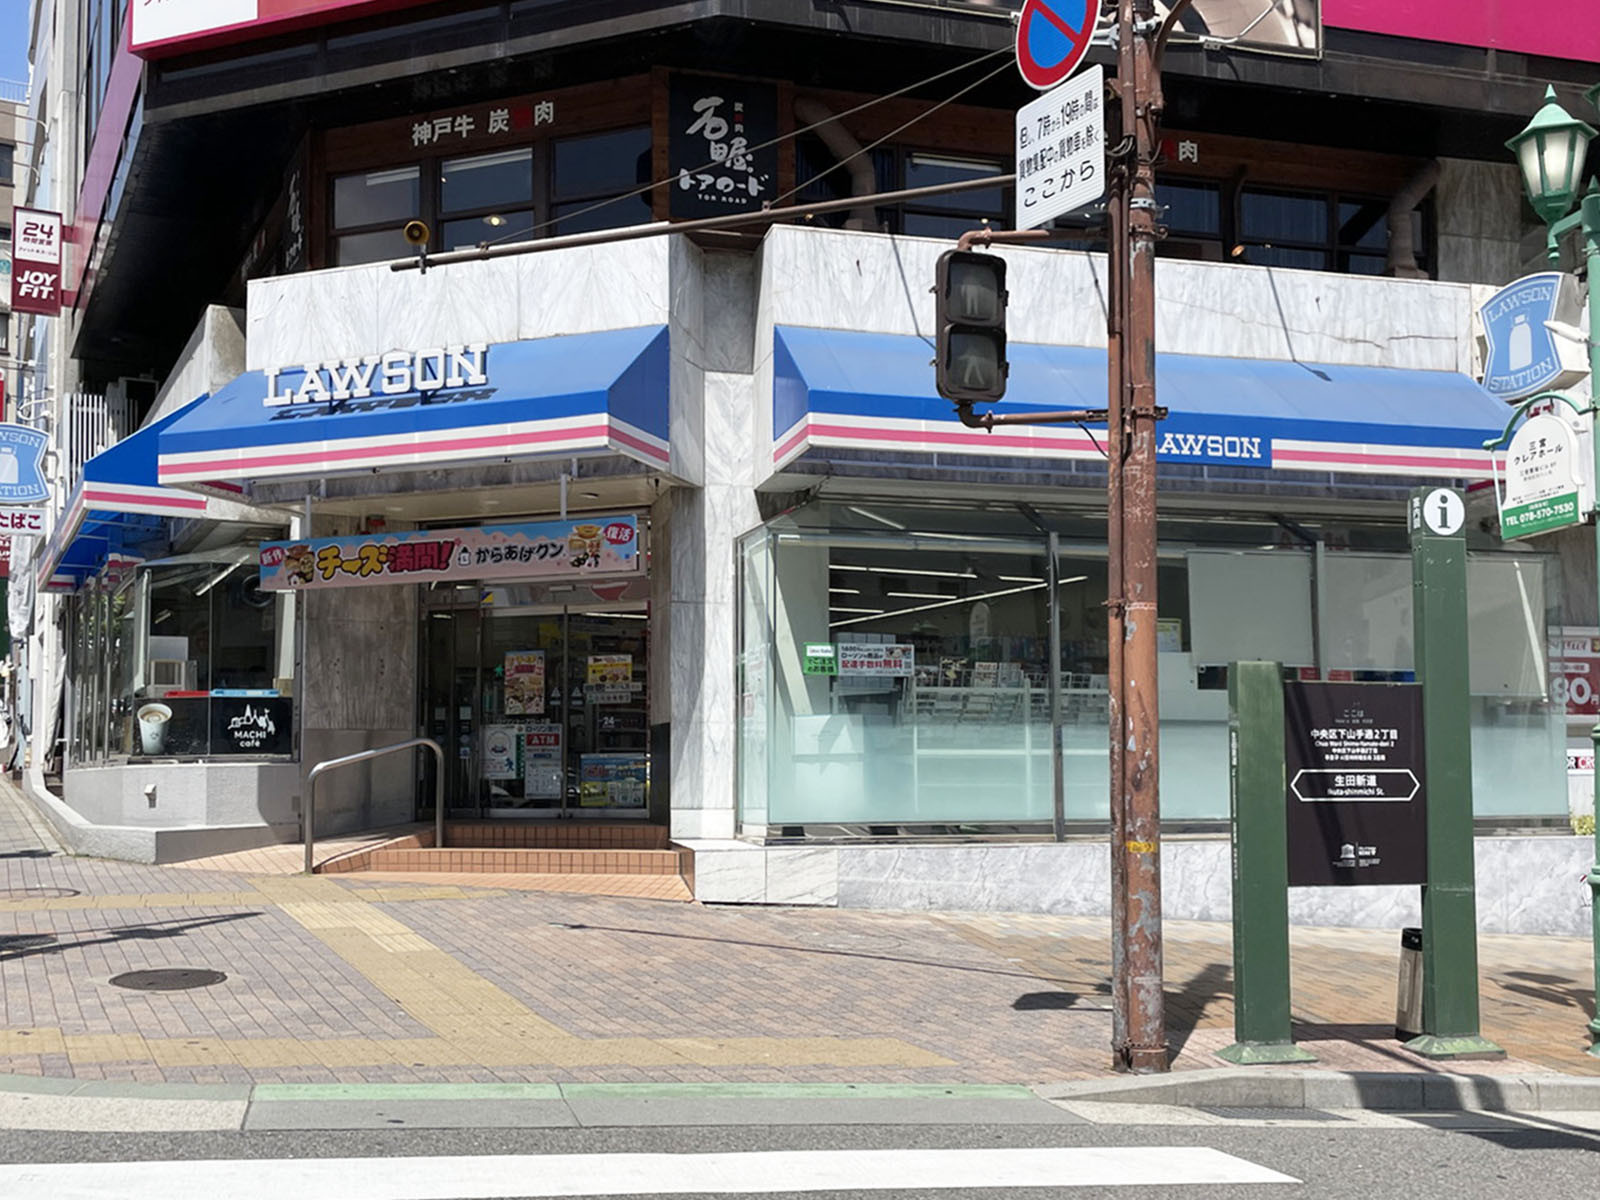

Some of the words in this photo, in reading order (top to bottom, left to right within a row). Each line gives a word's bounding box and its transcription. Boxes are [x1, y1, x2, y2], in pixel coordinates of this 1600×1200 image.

[412, 115, 475, 146] 神戸牛
[1024, 160, 1095, 208] ここから
[23, 221, 54, 239] 24
[16, 270, 57, 286] JOY
[19, 283, 54, 299] FIT
[1488, 286, 1551, 323] LAWSON
[263, 343, 488, 407] LAWSON
[1490, 358, 1554, 391] STATION
[1155, 433, 1261, 458] AWSON
[1505, 516, 1519, 526] TEL
[475, 542, 564, 563] からあげクン
[234, 730, 267, 739] MACHI
[531, 734, 556, 744] ATM
[1310, 728, 1398, 740] 中央区下山手通2丁目
[239, 739, 260, 748] café
[1335, 774, 1377, 786] 生田新道
